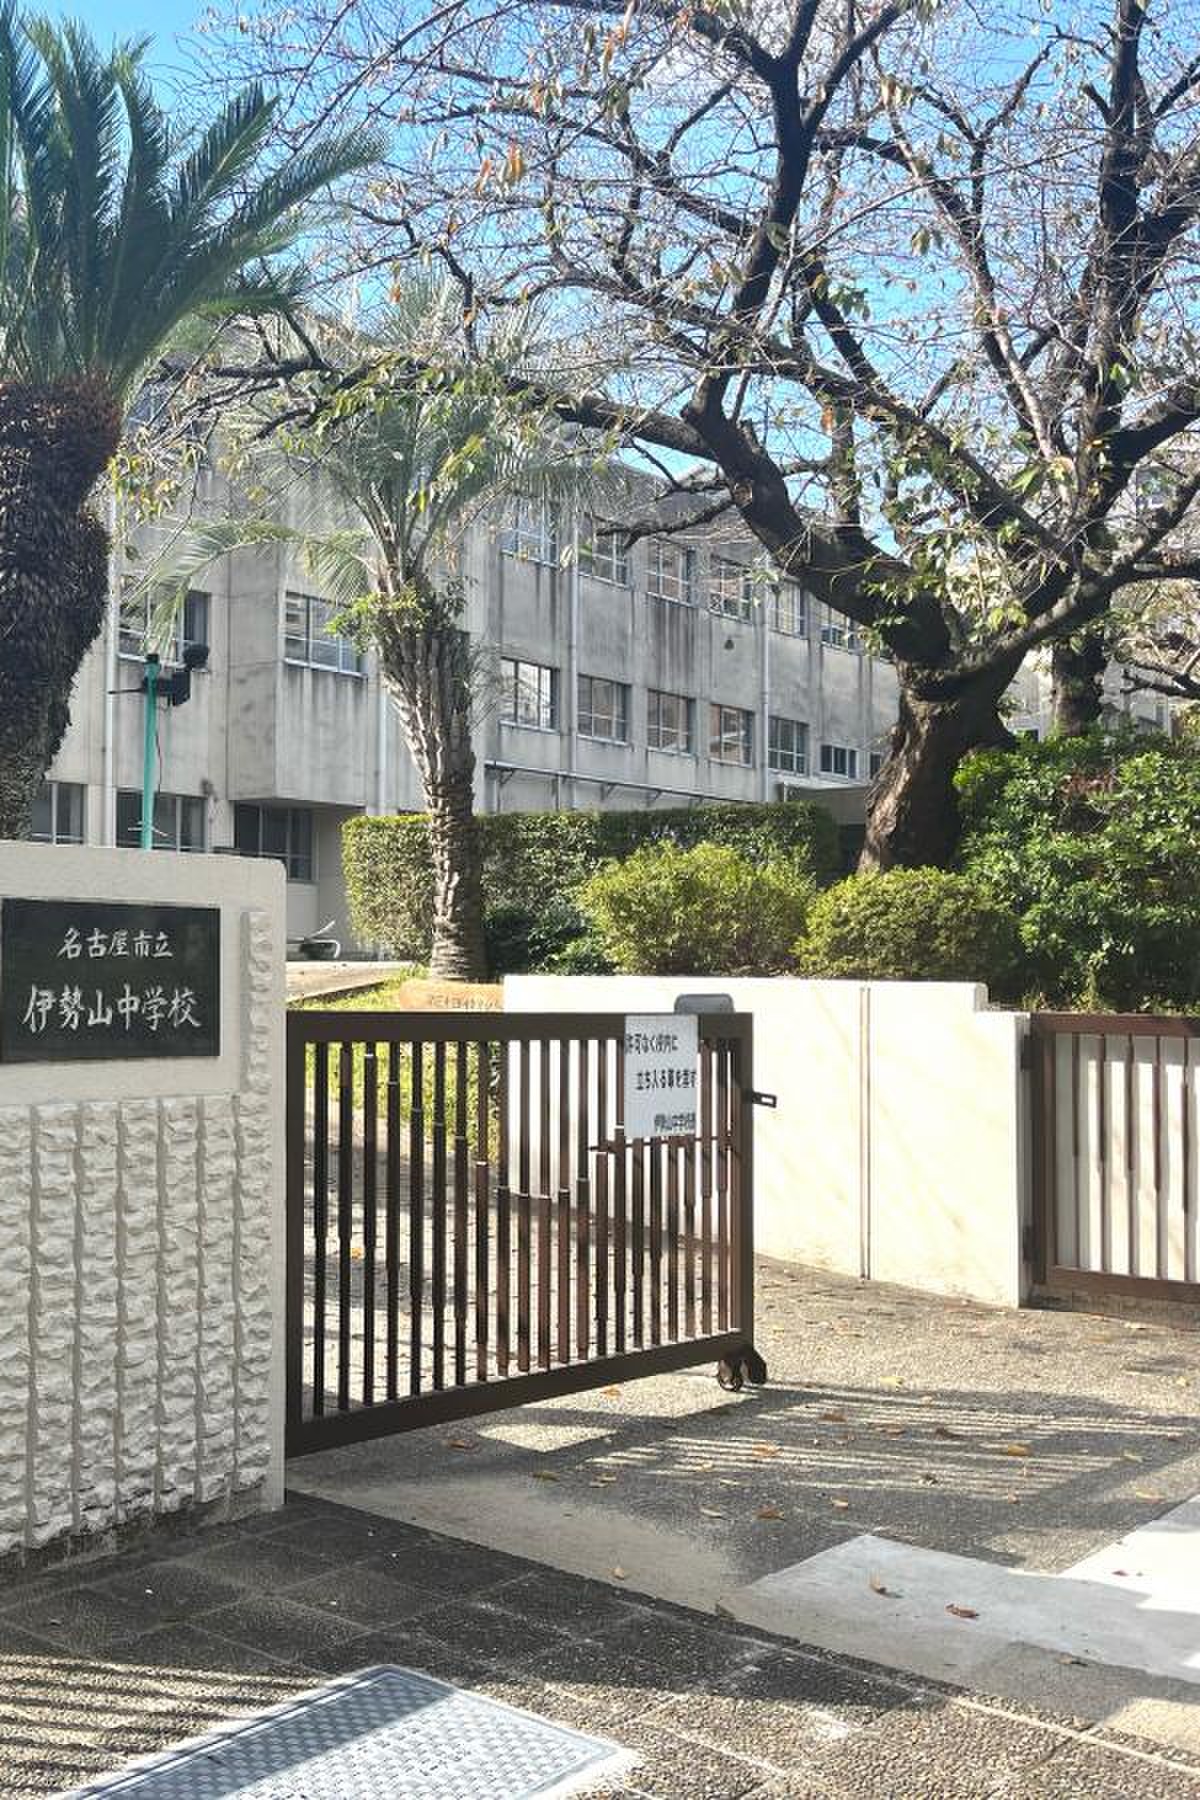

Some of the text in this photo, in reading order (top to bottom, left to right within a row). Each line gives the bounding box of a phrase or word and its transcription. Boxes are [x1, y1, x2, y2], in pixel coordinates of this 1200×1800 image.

[58, 926, 174, 960] 名古屋市立
[23, 983, 201, 1033] 伊勢山中学校
